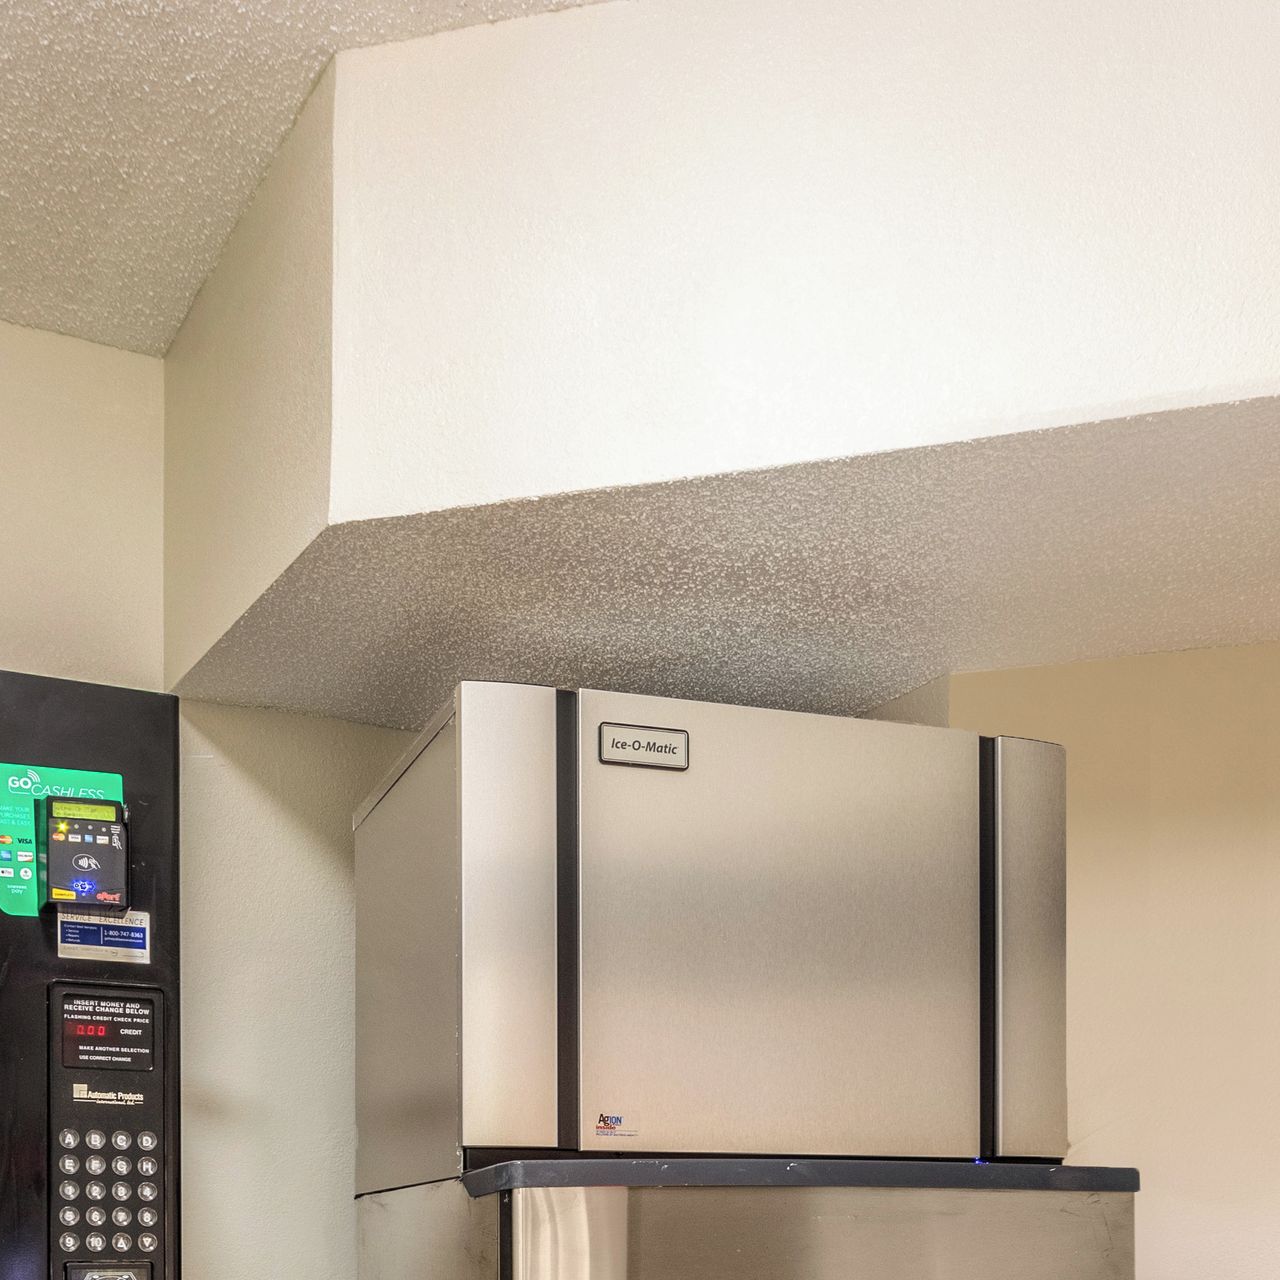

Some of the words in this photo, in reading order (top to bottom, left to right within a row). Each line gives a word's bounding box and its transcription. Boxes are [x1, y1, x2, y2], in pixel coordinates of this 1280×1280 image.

[611, 738, 677, 755] Ice-O-Matic
[8, 776, 32, 789] GO
[88, 1091, 117, 1099] Automatic
[118, 1092, 144, 1100] Products
